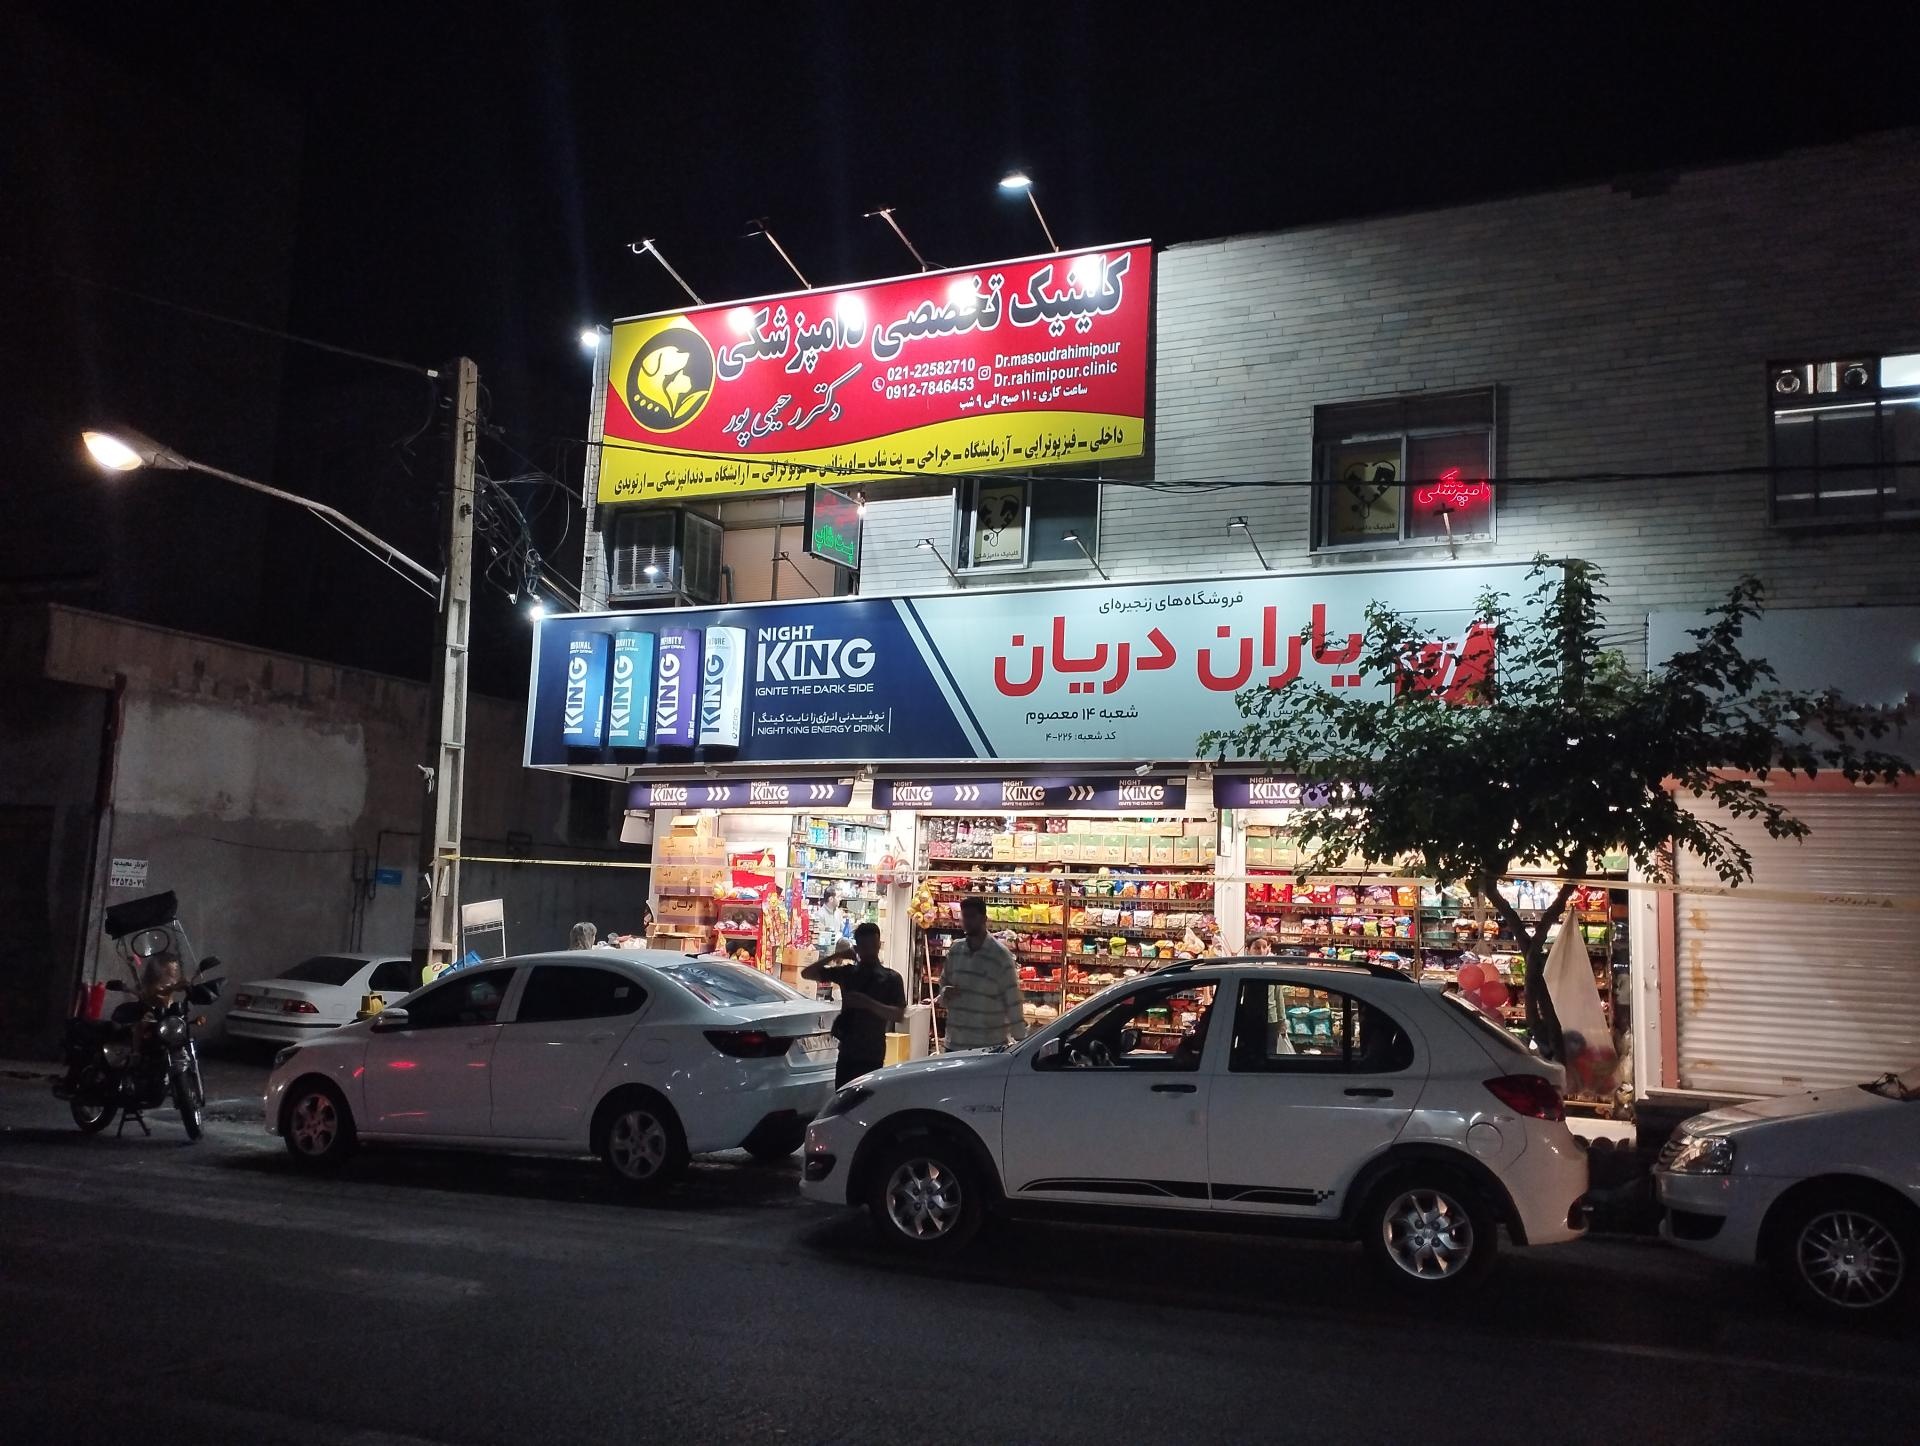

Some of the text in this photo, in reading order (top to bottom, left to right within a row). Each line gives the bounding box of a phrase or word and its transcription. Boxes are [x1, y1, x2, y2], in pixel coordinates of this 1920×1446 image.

[717, 252, 1131, 381] کلینیک تخصصی دامپزشکی
[995, 341, 1121, 369] Dr.masoudrahimipour
[887, 357, 976, 382] 021-22582710
[993, 360, 1118, 388] Dr.rahimipour.clinic
[885, 376, 975, 400] 0912-7846453
[959, 383, 1088, 411] ساعت کاری ۱۱ صبح الی ۹ شب
[722, 362, 862, 447] دکتر رحیمی پور
[964, 434, 1013, 463] آزمایشگاه
[1089, 424, 1124, 452] داخلی
[917, 444, 951, 470] جراحی
[614, 472, 647, 495] ارتوپدی
[656, 467, 704, 492] دندانپزشکی
[1099, 590, 1244, 614] فروشگاه‌های زنجیره‌ای
[758, 625, 814, 642] NIGHT
[993, 615, 1177, 697] دریان
[1197, 603, 1363, 692] یاران
[756, 638, 876, 682] KING
[563, 657, 588, 734] KING
[609, 655, 634, 737] KING
[655, 653, 681, 735] KING
[701, 654, 725, 734] KING
[755, 682, 875, 697] IGNITE THE DARK SIDE
[758, 711, 784, 725] کینگ
[785, 712, 809, 723] نایت
[838, 709, 885, 724] نوشیدنی
[1025, 704, 1138, 725] شعبه ۱۴ معصوم
[757, 723, 885, 735] NIGHT KING ENERGY DRINK
[1104, 731, 1117, 740] کد
[650, 788, 688, 802] KING
[750, 786, 790, 801] KING
[892, 786, 933, 801] KING
[1002, 786, 1045, 801] KING
[1118, 785, 1164, 801] KING
[1249, 783, 1300, 800] KING
